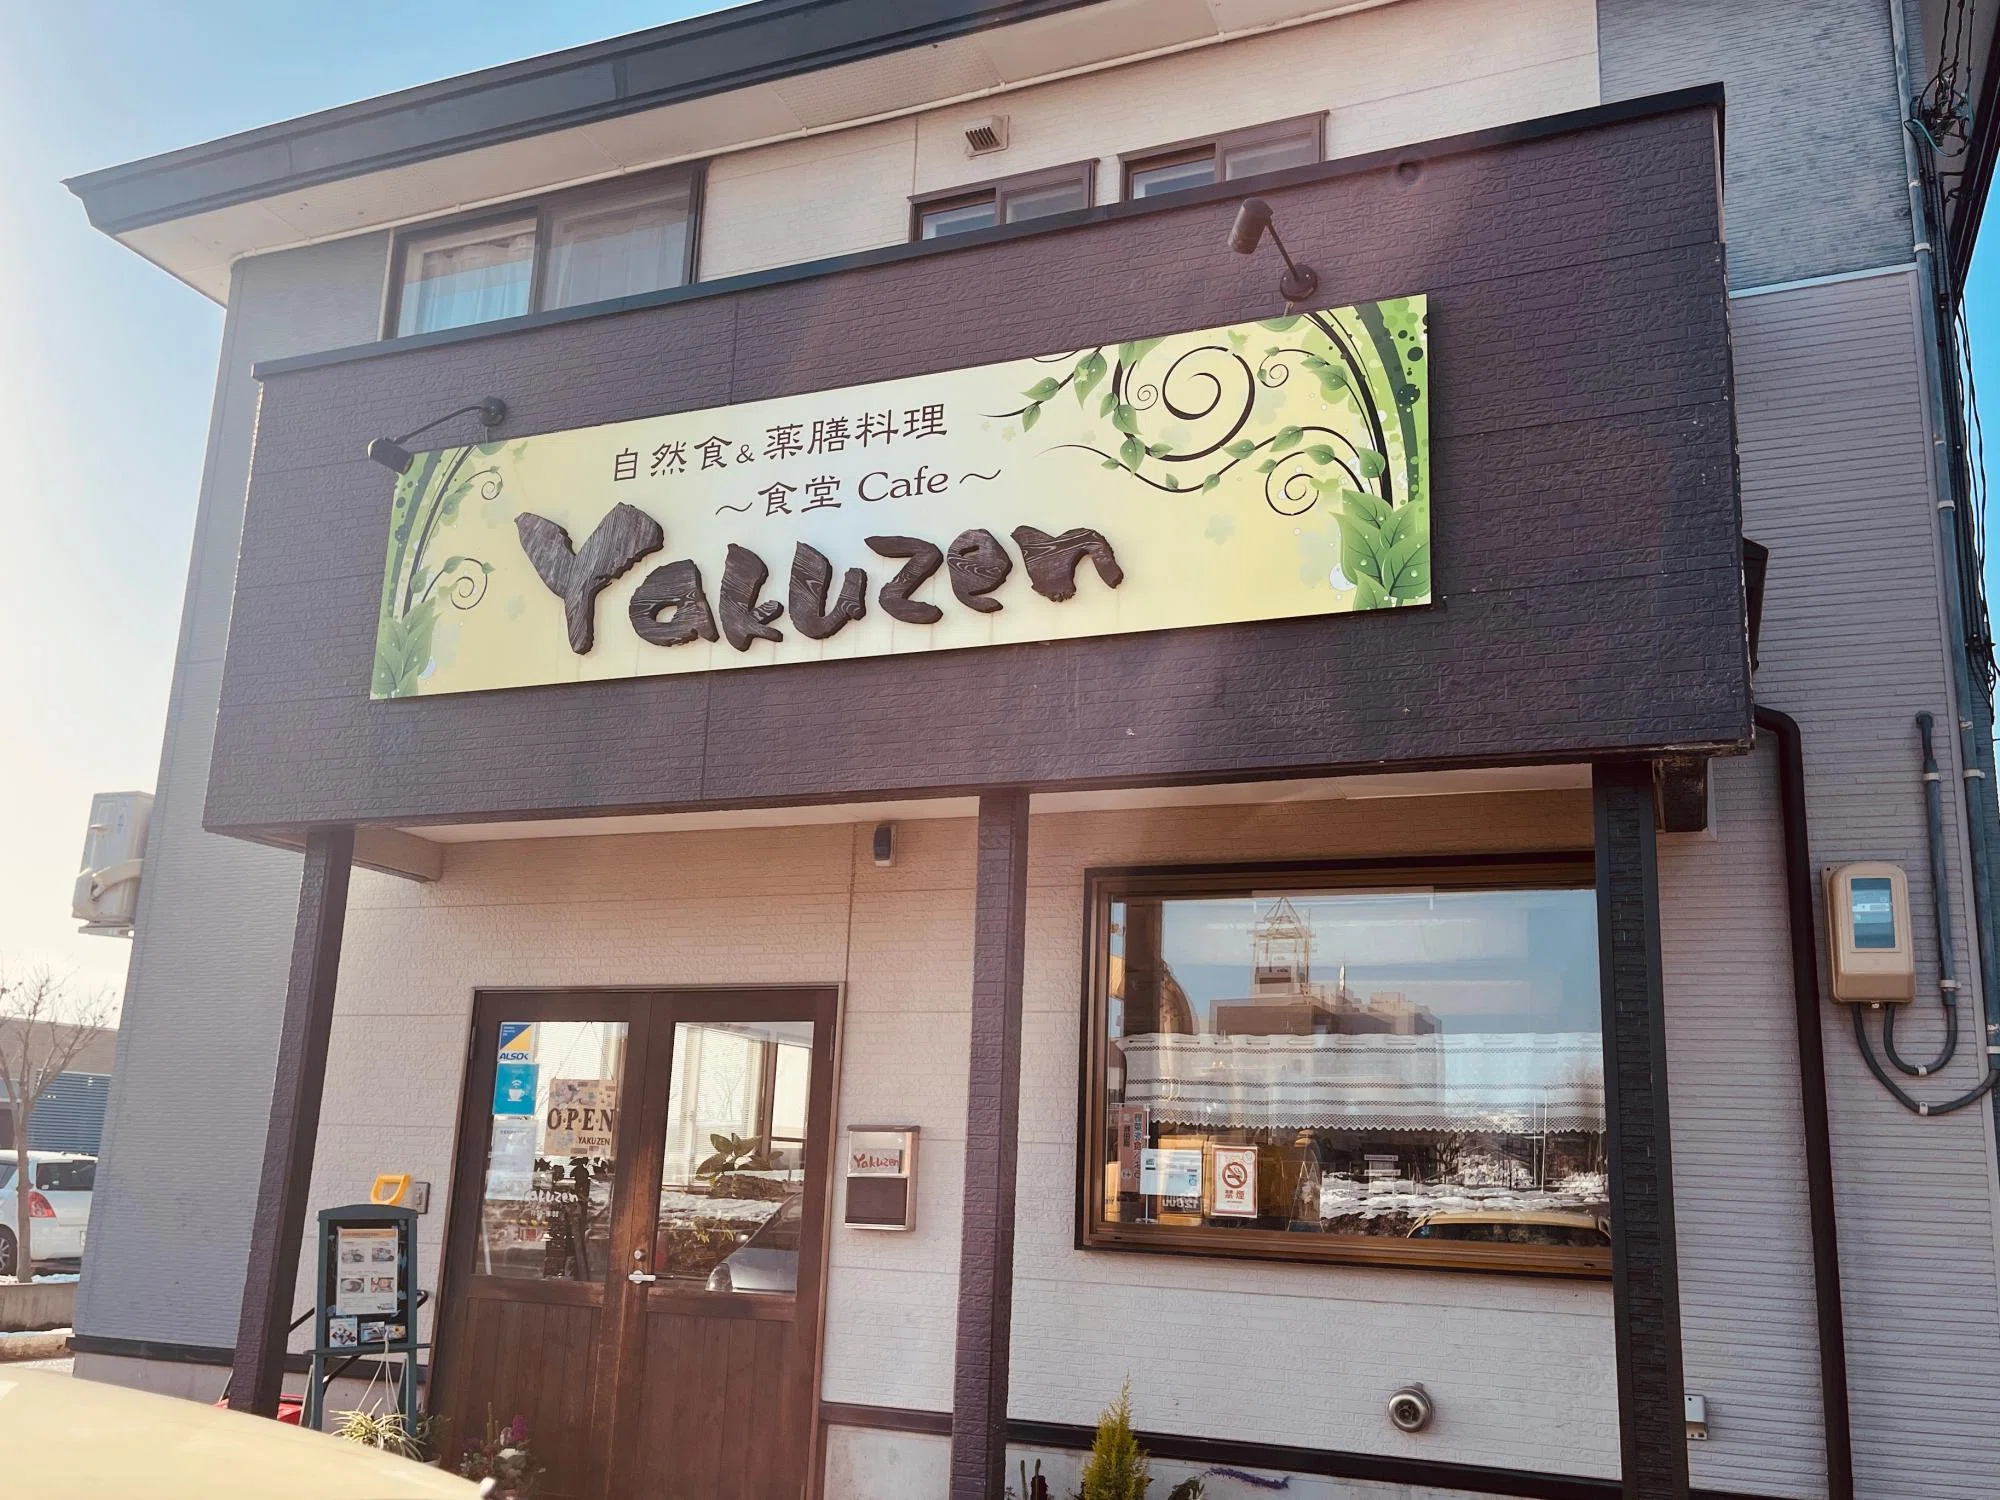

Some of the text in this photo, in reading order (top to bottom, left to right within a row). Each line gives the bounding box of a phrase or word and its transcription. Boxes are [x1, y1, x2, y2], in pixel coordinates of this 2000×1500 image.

[514, 501, 1125, 656] Yakuzen
[500, 1052, 529, 1061] ALSOK
[577, 1136, 611, 1146] YAKUZEN
[853, 1152, 900, 1169] Yakuzen
[1224, 1189, 1245, 1200] 禁煙
